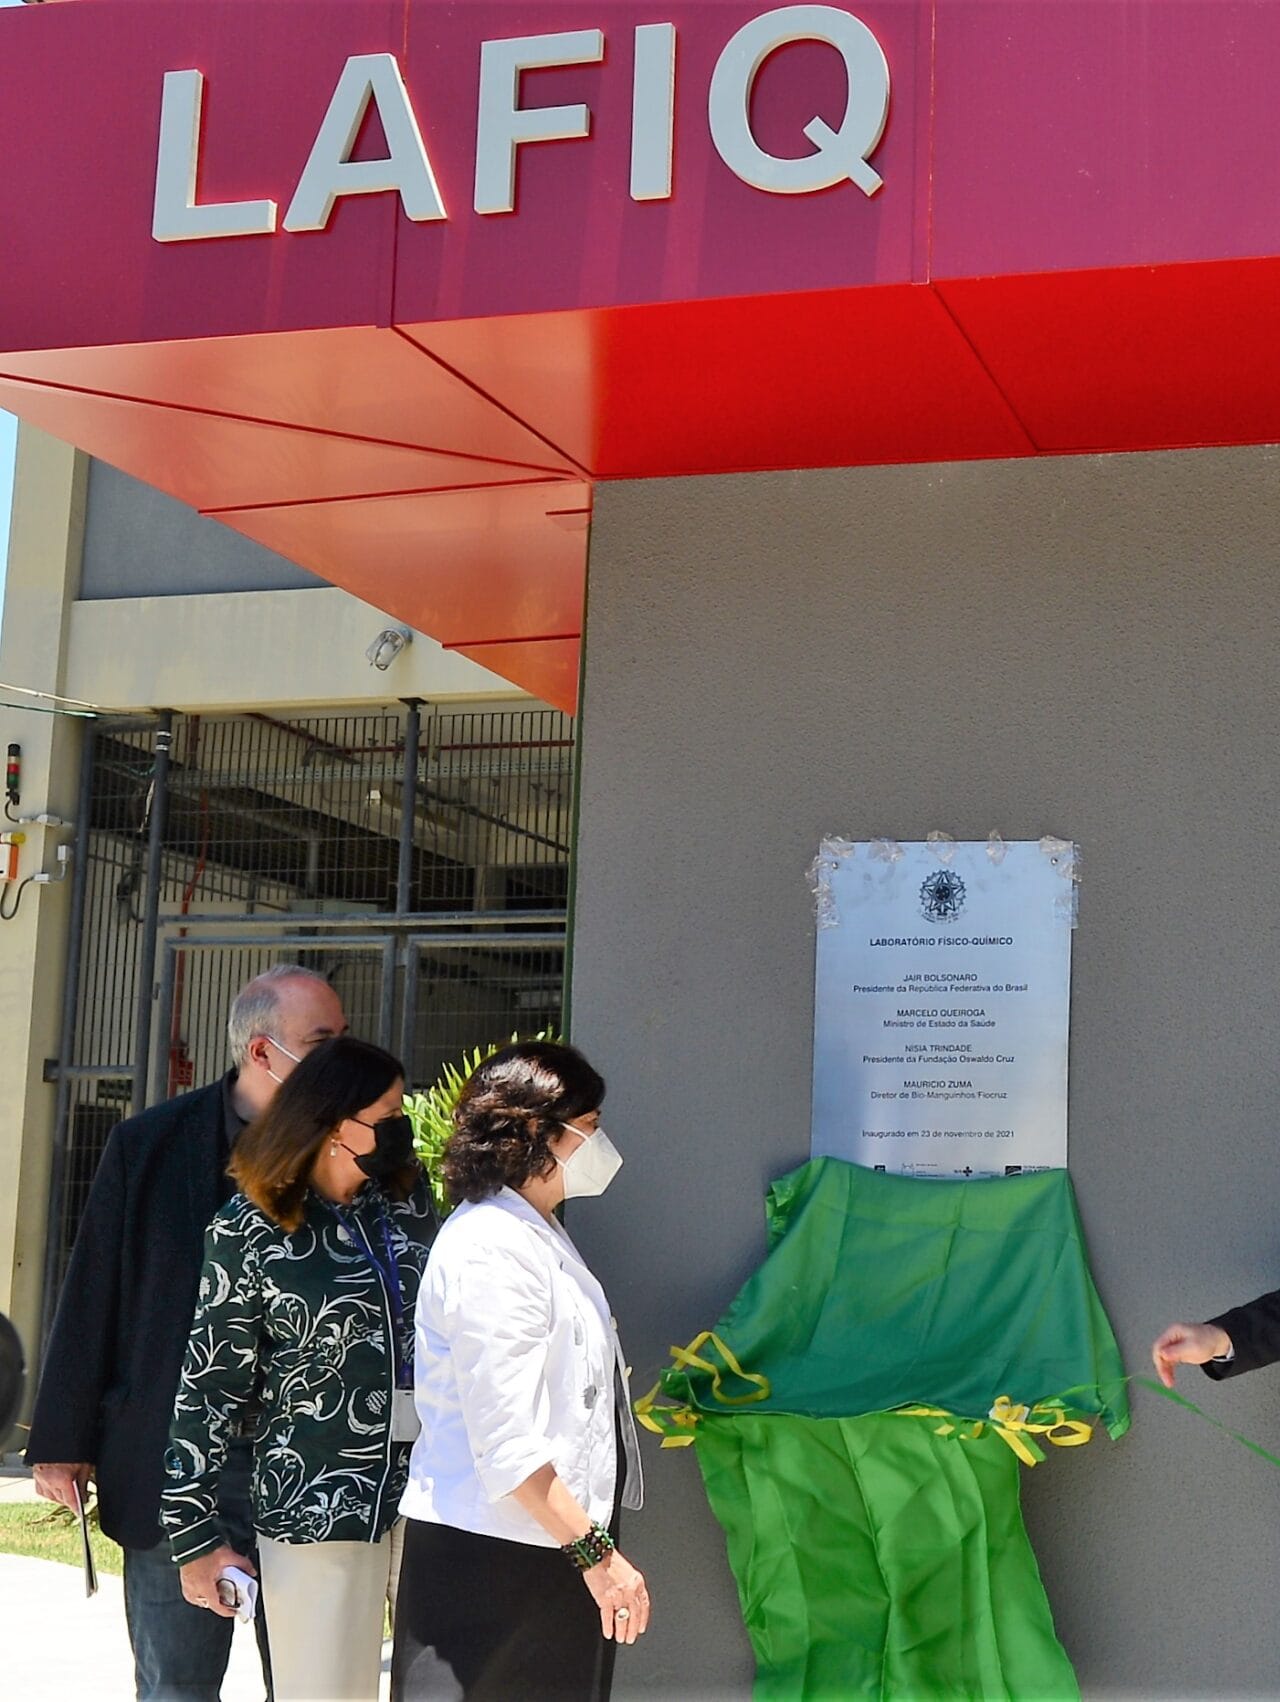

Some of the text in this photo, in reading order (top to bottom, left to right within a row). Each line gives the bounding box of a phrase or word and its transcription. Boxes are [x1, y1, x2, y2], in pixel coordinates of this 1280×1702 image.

[152, 5, 891, 243] LAFIQ
[870, 936, 1013, 947] LABORATÓRIO FÍSICO-QUÍMICO
[903, 973, 978, 983] JAIR BOLSONARO
[854, 983, 895, 993] Presidente
[896, 984, 907, 993] da
[951, 983, 992, 993] Federativa
[992, 983, 1004, 993] do
[1006, 983, 1029, 993] Brasil
[897, 1008, 986, 1018] MARCELO QUEIROGA
[883, 1019, 915, 1028] Ministro
[916, 1019, 928, 1028] de
[929, 1019, 957, 1028] Estado
[957, 1019, 969, 1028] da
[930, 1044, 973, 1053] TRINDADE
[863, 1054, 1015, 1065] Presidente da Fundação Oswaldo Cruz
[947, 1080, 973, 1089] ZUMA
[871, 1090, 898, 1100] Diretor
[898, 1090, 910, 1100] de
[862, 1129, 1015, 1141] Inaugurado em 23 de novembro de 2021
